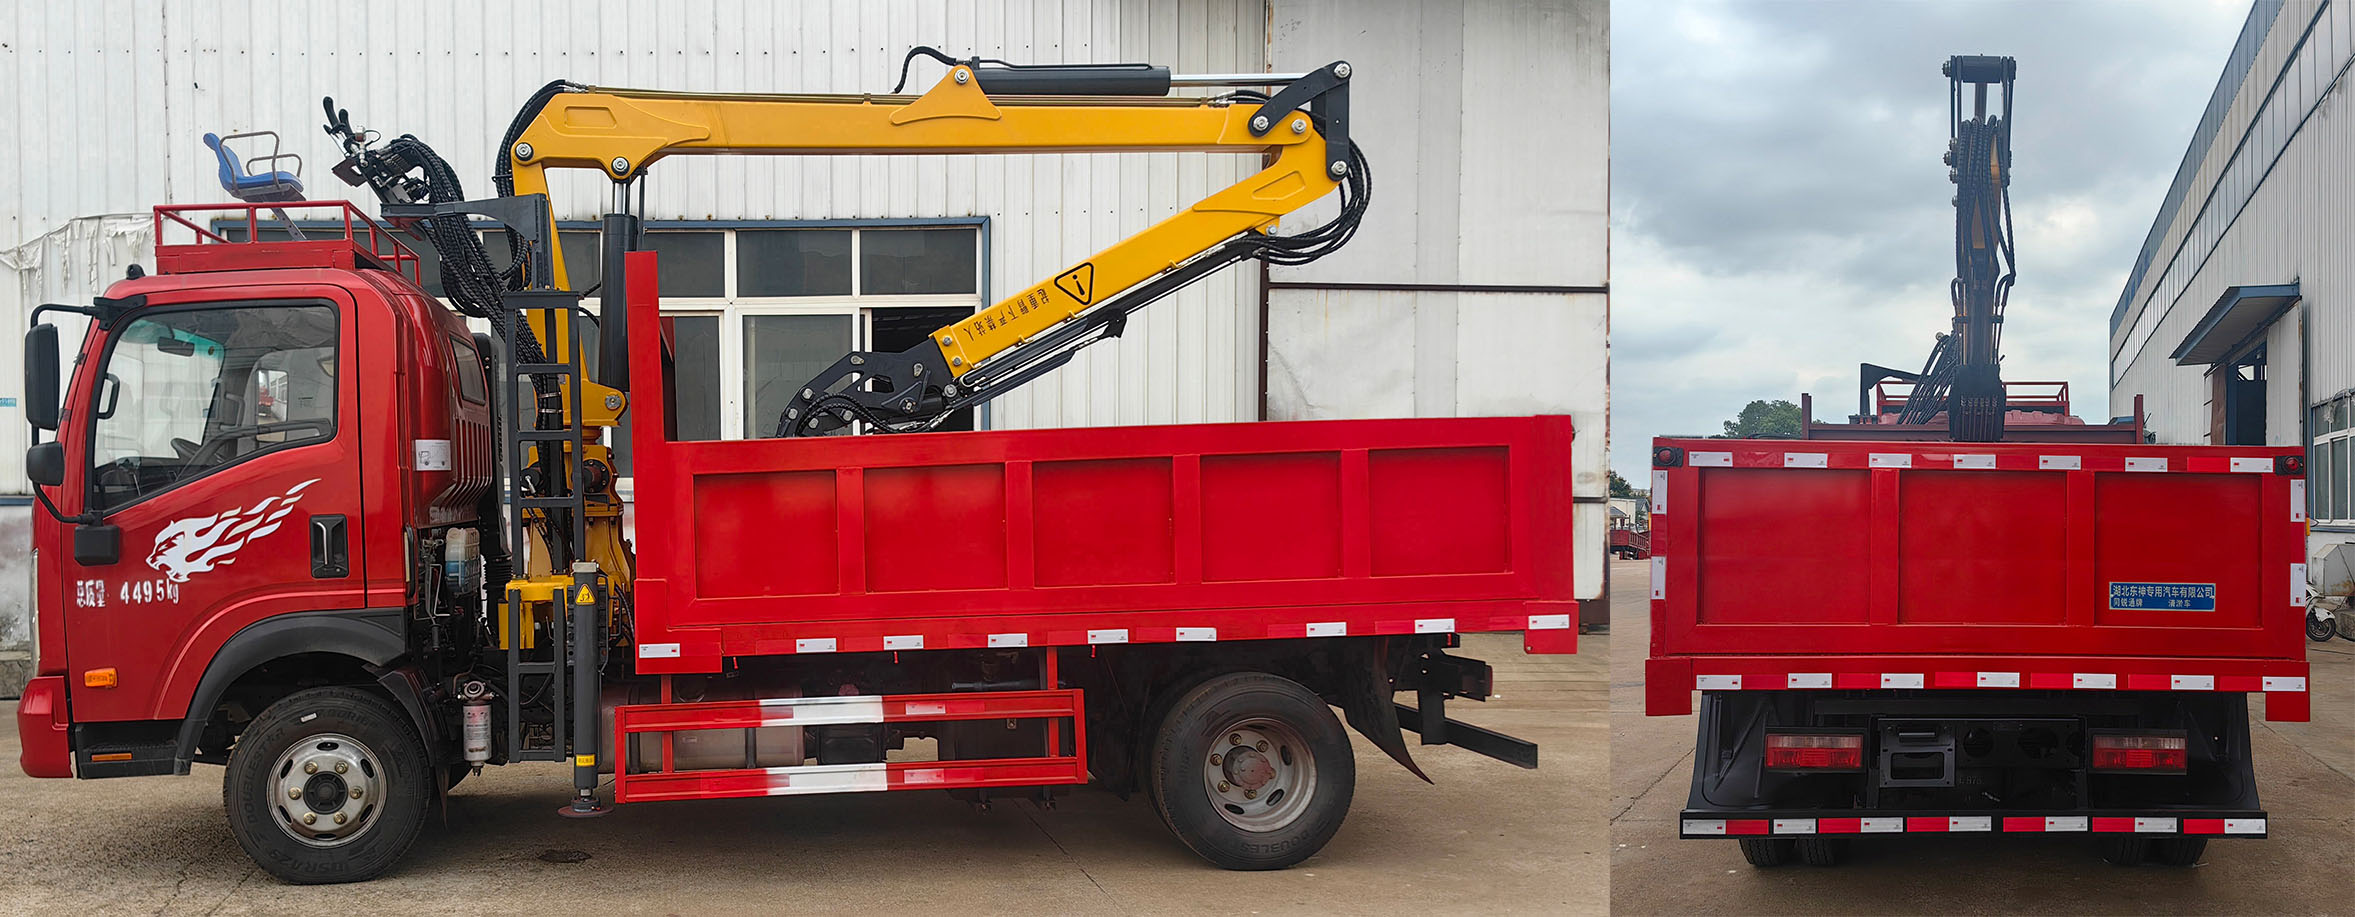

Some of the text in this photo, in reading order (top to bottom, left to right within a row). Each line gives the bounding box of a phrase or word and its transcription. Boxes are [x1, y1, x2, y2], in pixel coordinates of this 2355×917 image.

[963, 288, 1051, 342] 起重臂下严禁站人
[120, 577, 180, 604] 4495kg
